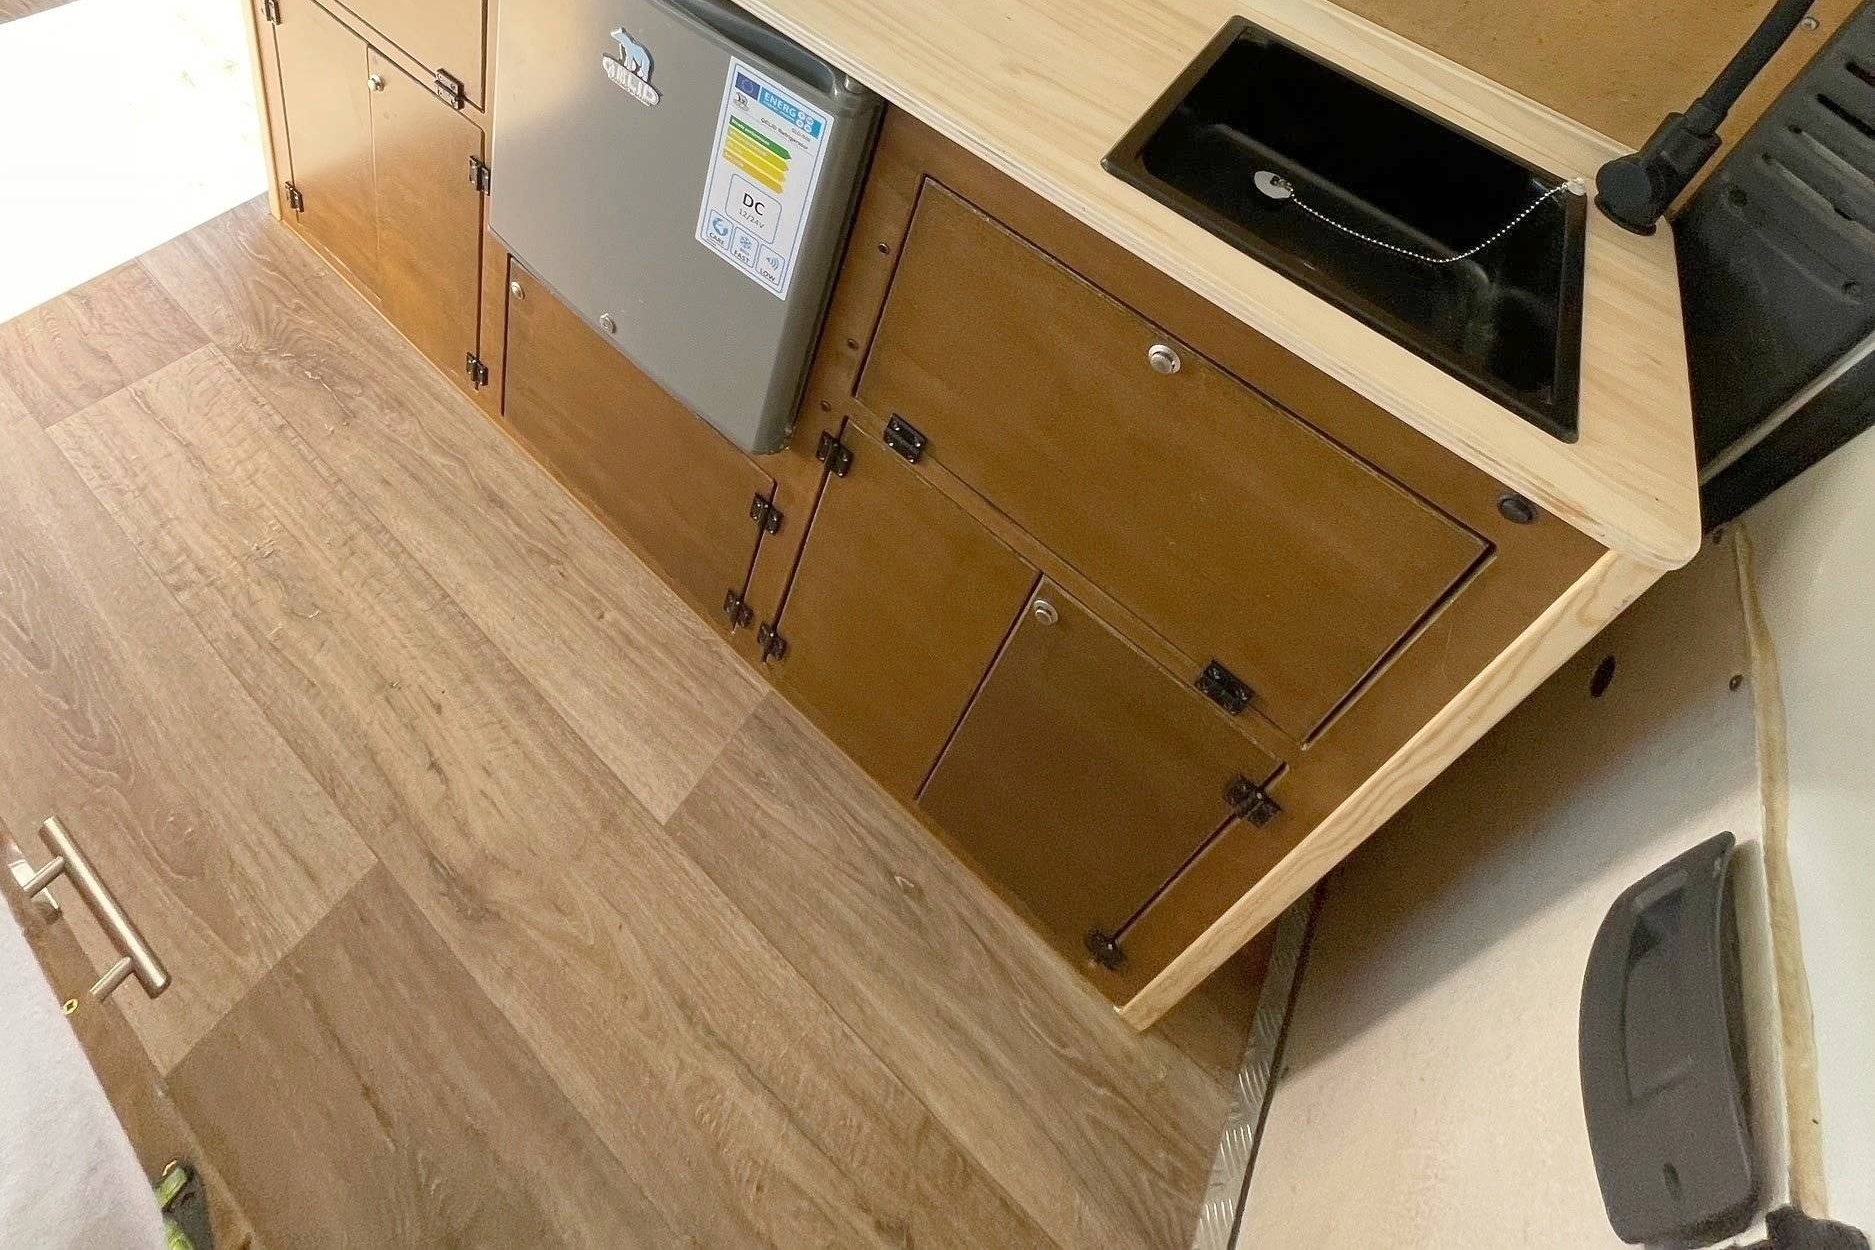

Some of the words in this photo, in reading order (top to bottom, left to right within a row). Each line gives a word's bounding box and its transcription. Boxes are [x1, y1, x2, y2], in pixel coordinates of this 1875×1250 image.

[764, 92, 796, 118] ENERG
[742, 192, 765, 216] DC
[738, 208, 765, 229] 12/24V
[733, 249, 750, 264] FAST
[759, 268, 776, 282] LOW
